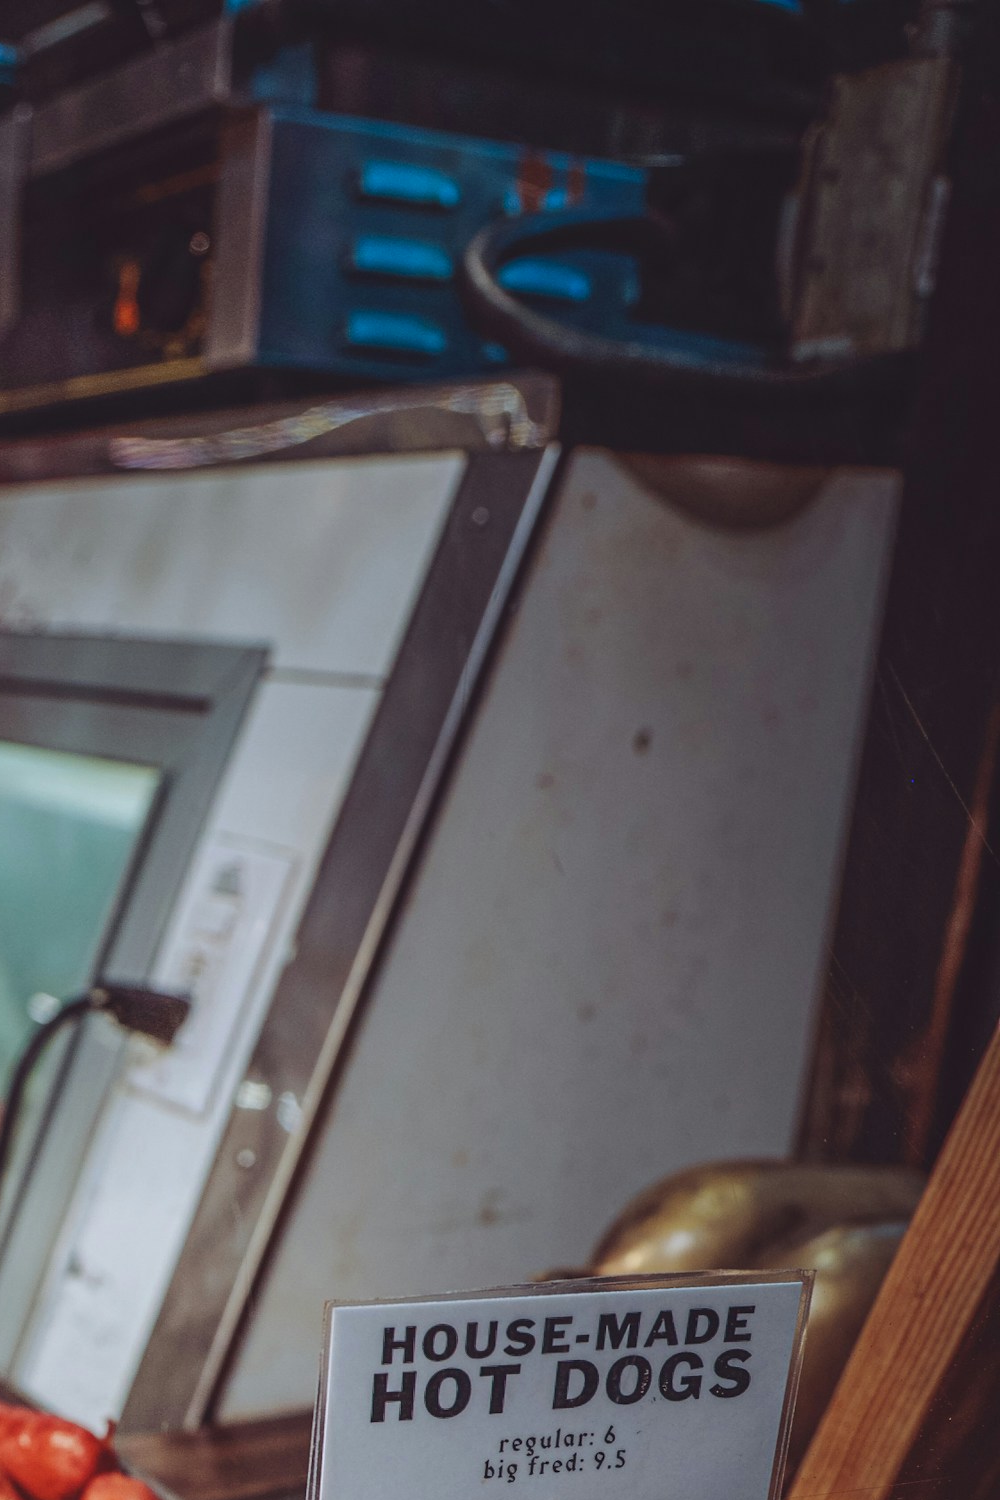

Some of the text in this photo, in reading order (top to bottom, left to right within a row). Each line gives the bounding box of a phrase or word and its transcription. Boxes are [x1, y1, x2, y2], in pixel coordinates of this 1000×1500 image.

[381, 1305, 756, 1365] HOUSE-MADE
[370, 1348, 753, 1423] HOT DOGS
[498, 1425, 616, 1457] regular: 6
[483, 1449, 627, 1483] big fred: 9.5
